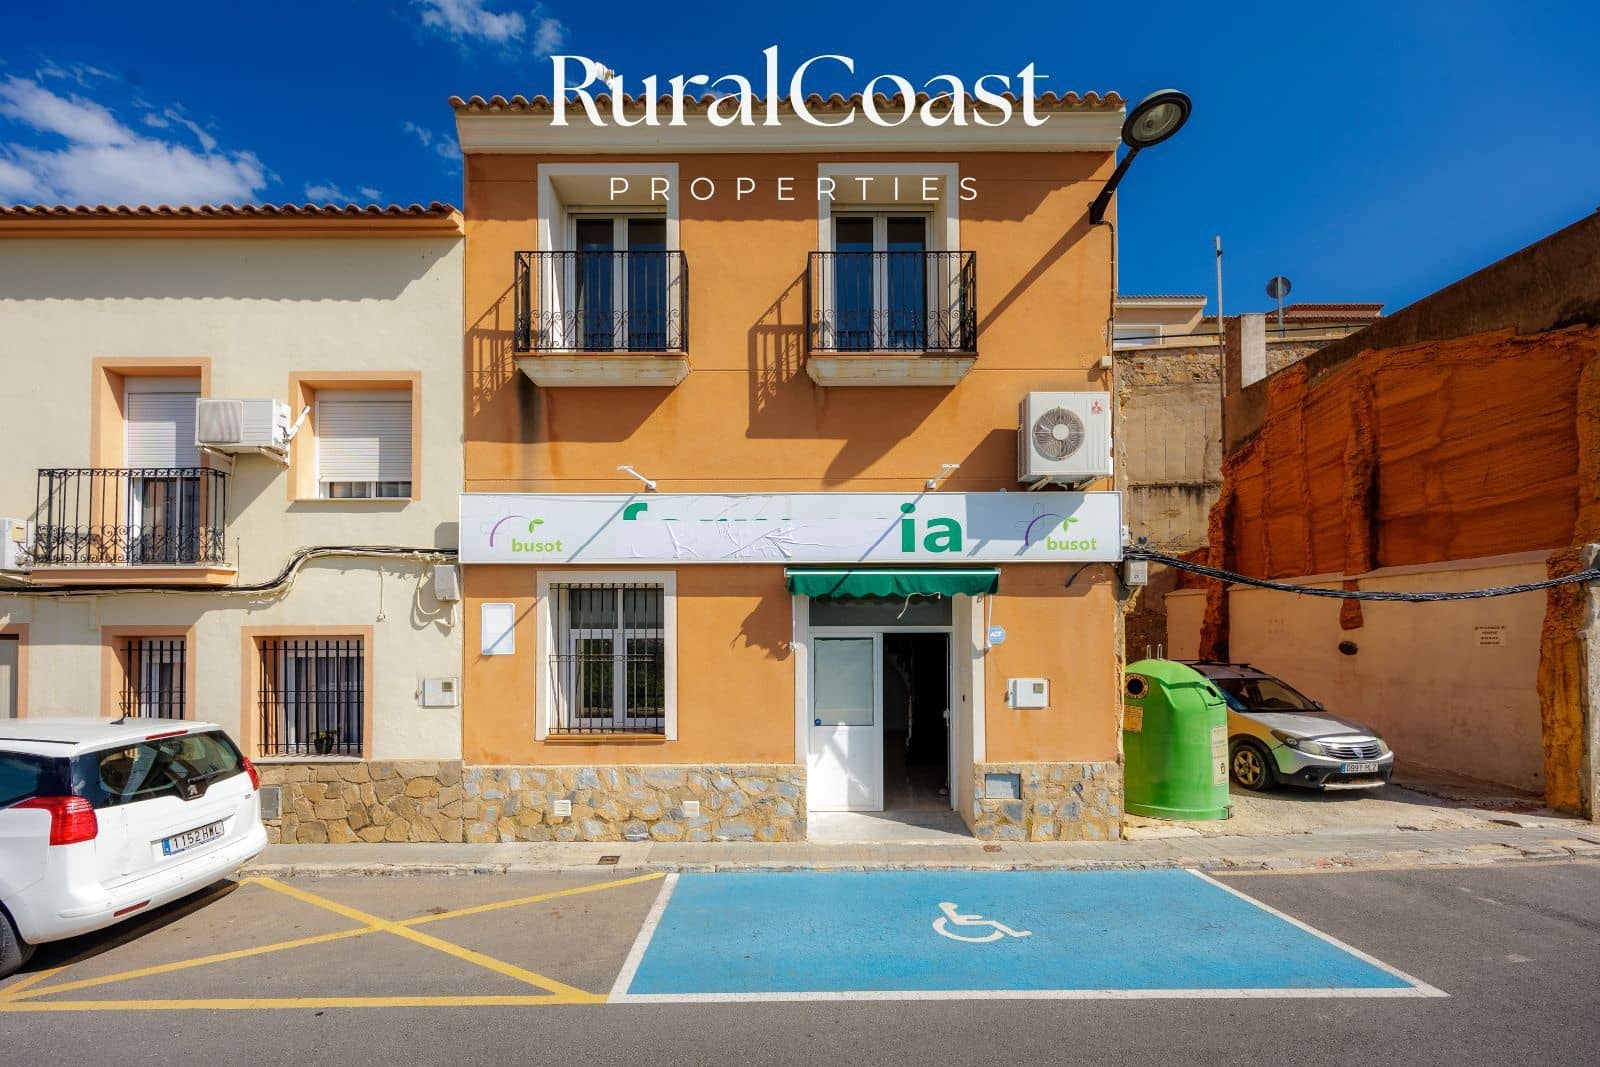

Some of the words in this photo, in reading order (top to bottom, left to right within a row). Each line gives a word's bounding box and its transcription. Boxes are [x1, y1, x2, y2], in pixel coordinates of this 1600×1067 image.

[512, 538, 563, 553] busot
[1047, 536, 1097, 551] busot
[173, 832, 201, 848] 1152
